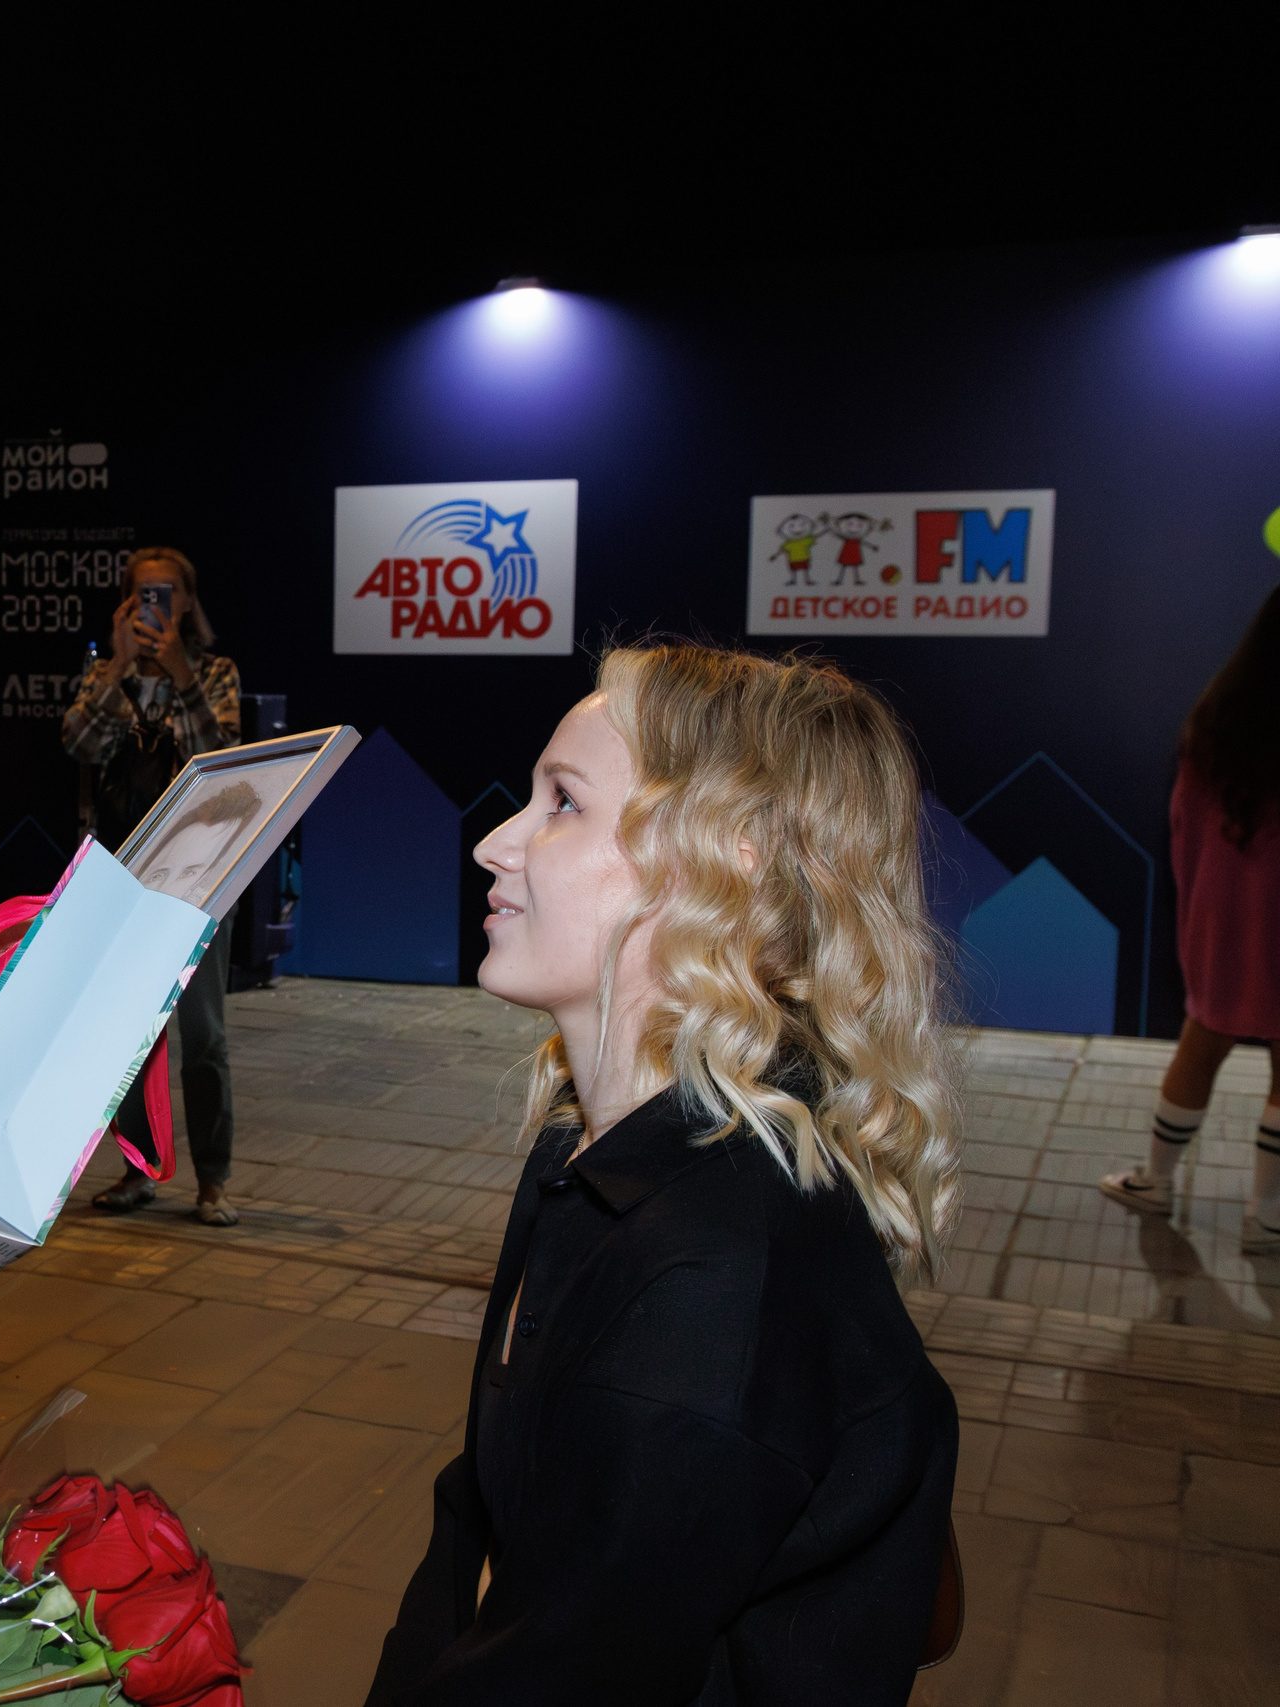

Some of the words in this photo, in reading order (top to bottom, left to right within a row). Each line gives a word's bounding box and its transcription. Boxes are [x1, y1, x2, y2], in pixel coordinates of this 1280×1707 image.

[915, 509, 1031, 583] FM
[354, 556, 483, 599] АВТО
[1, 595, 83, 632] 2030
[391, 598, 552, 640] РАДИО
[769, 596, 898, 620] ДЕТСКОЕ
[914, 594, 1027, 620] РАДИО
